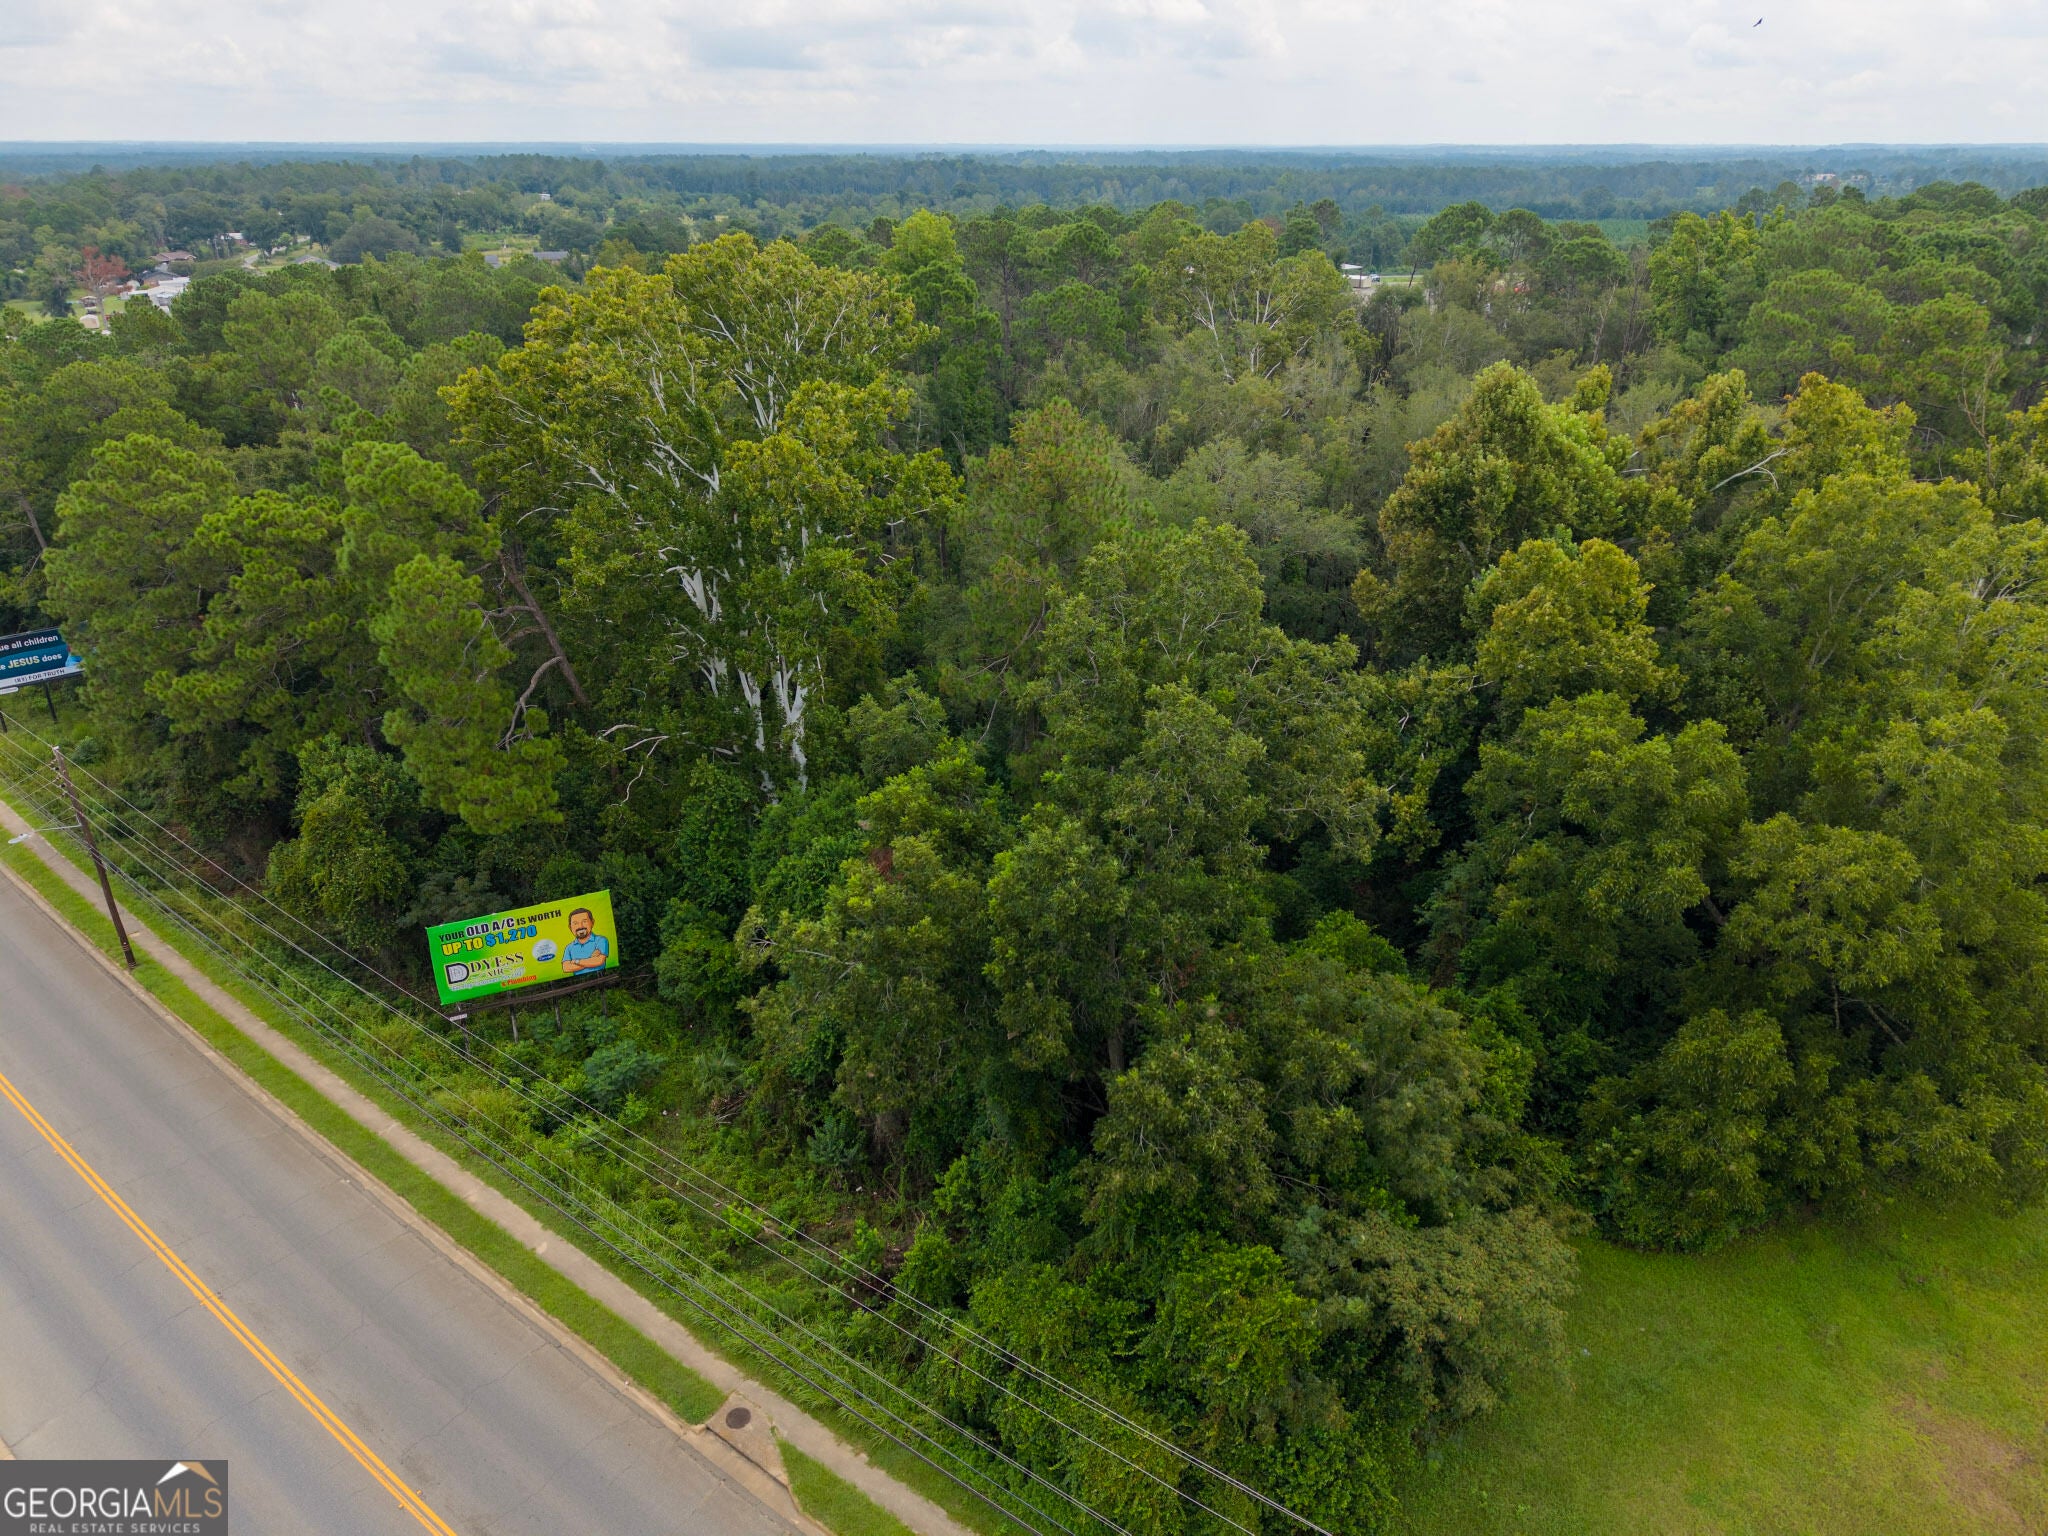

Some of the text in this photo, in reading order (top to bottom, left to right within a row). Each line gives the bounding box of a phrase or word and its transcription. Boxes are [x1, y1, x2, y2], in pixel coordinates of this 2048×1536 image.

[12, 641, 22, 649] all
[24, 635, 58, 647] children
[8, 655, 40, 669] JESUS
[42, 653, 62, 662] does
[439, 909, 562, 943] YOUR OLD A/C IS WORTH
[442, 924, 538, 956] UP TO $1,270
[470, 952, 524, 973] DYESS
